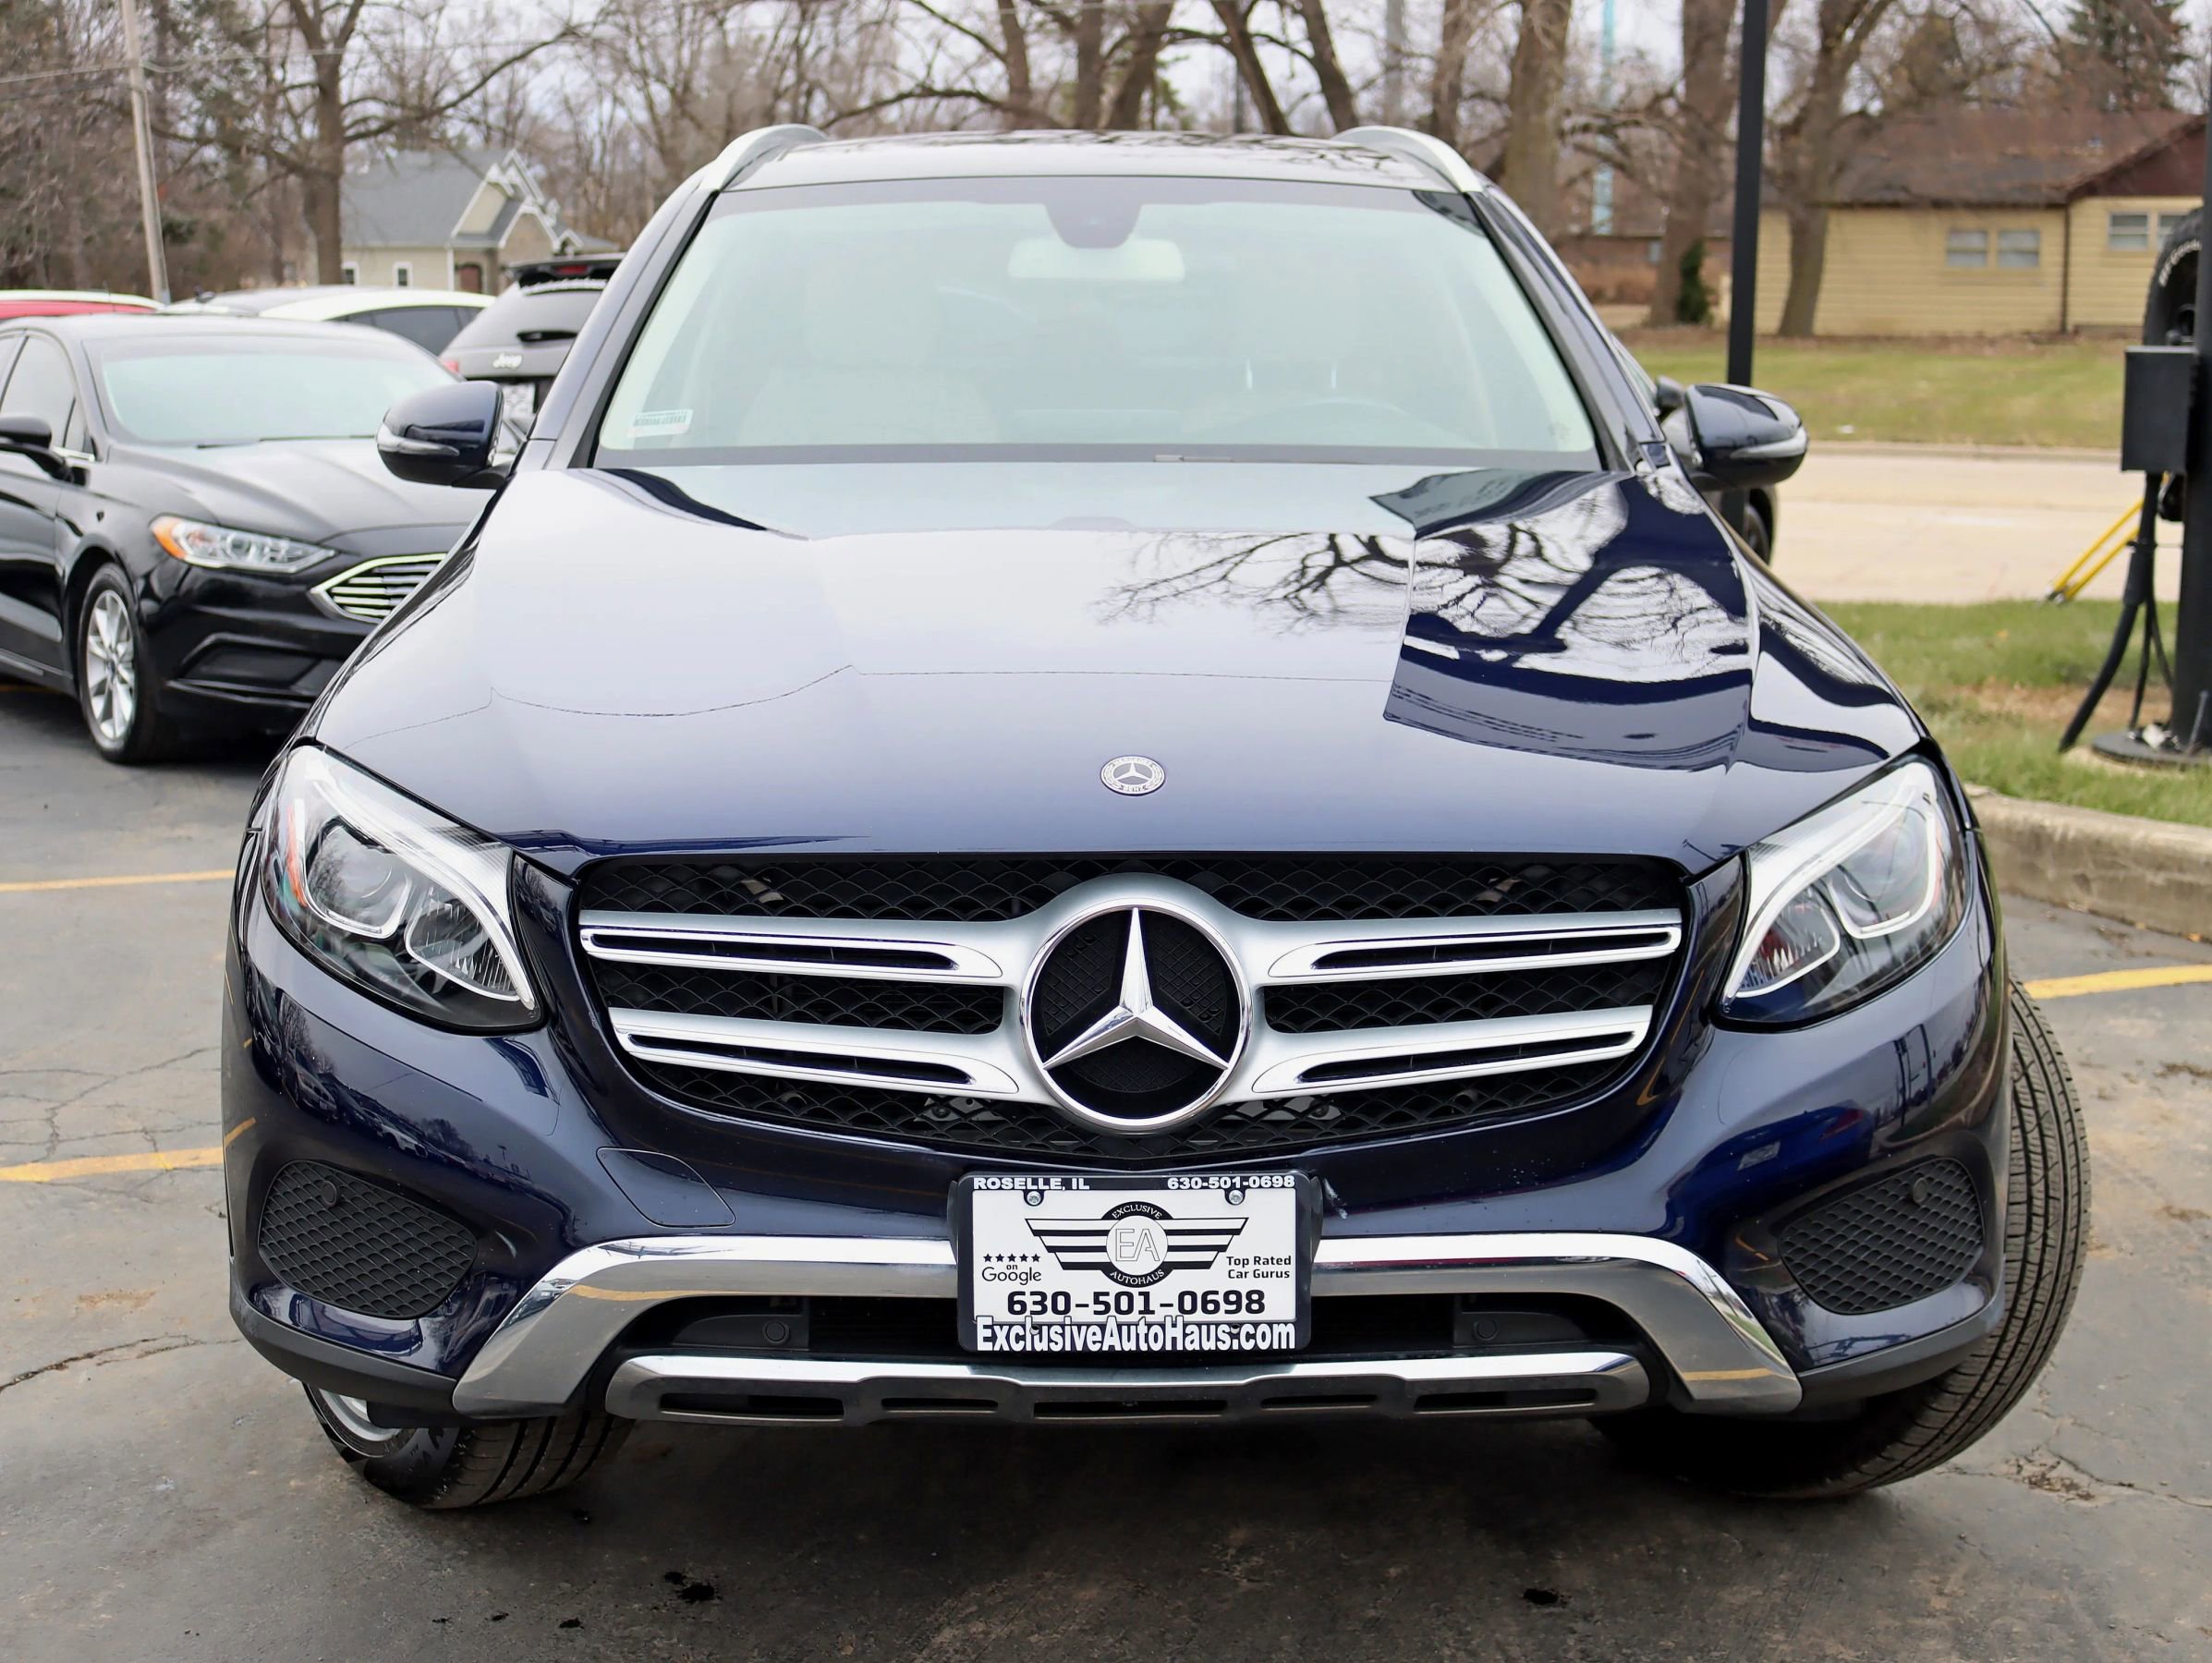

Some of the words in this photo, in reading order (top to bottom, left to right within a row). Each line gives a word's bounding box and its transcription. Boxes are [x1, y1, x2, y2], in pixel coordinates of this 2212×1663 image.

[973, 1177, 1065, 1191] ROSELLE,
[1072, 1178, 1089, 1189] IL
[1167, 1175, 1295, 1190] 630-501-0698
[1112, 1204, 1162, 1219] EXCLUSIVE
[1115, 1228, 1161, 1262] EA
[1226, 1256, 1250, 1268] Top
[1253, 1255, 1292, 1266] Rated
[981, 1266, 1042, 1286] Google
[1110, 1268, 1165, 1285] AUTOHAUS
[1228, 1268, 1250, 1279] Car
[1253, 1268, 1291, 1279] Gurus
[1007, 1290, 1265, 1316] 630-501-0698
[976, 1316, 1295, 1352] ExclusiveAutoHaus.com
